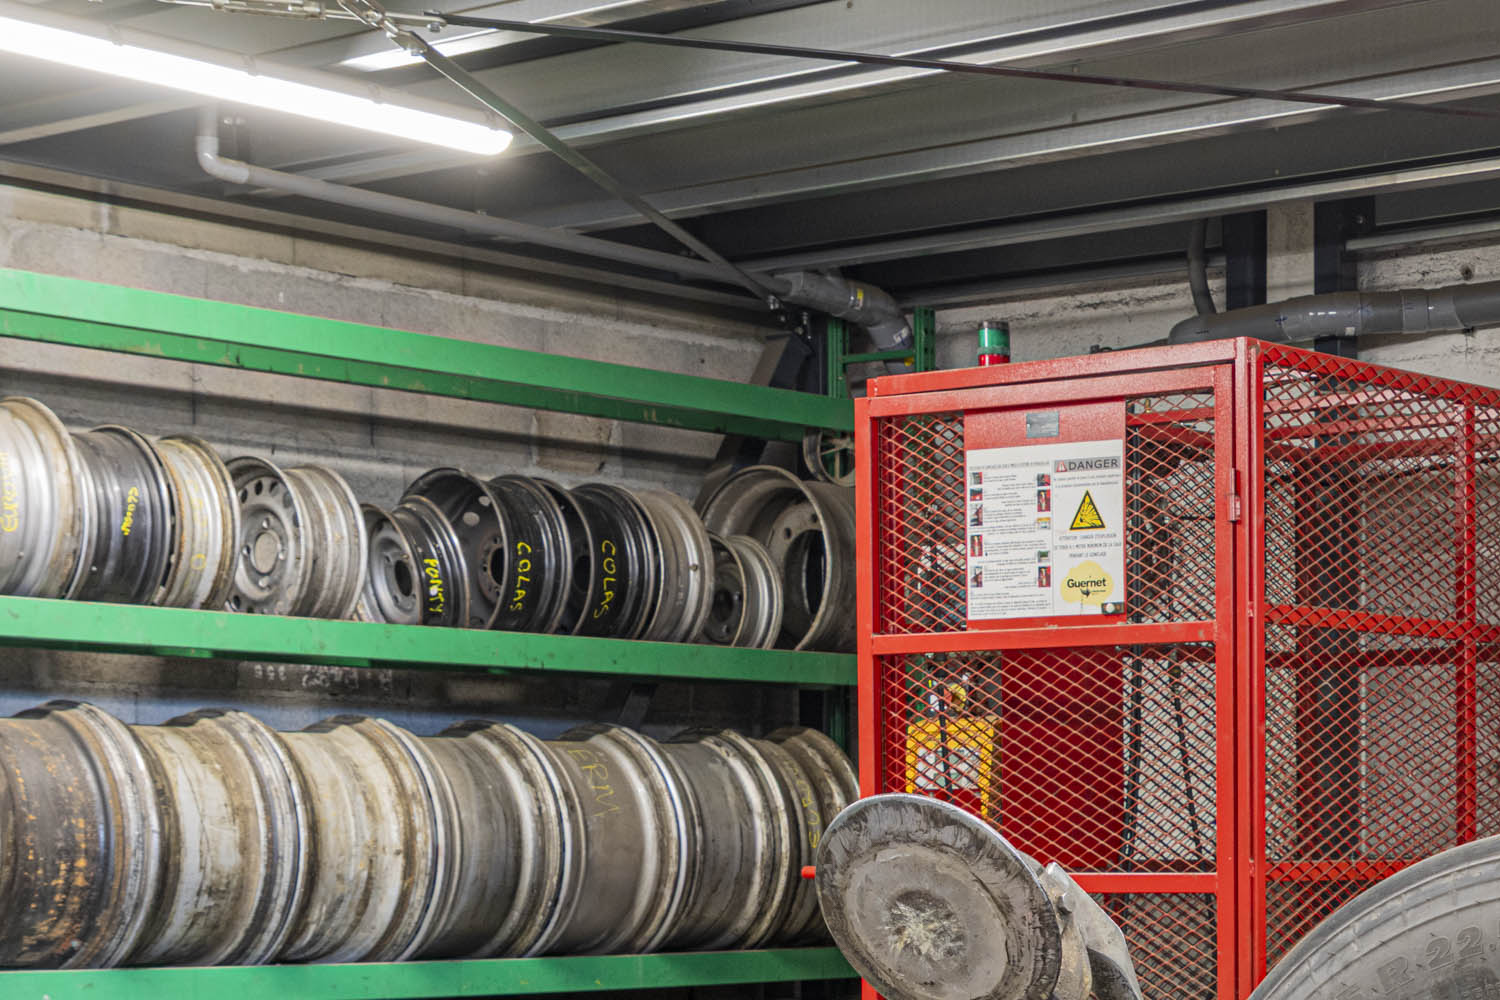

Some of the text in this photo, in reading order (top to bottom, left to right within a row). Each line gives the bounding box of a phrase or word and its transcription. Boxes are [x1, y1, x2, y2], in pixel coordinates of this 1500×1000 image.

[1068, 458, 1119, 471] DANGER
[423, 558, 445, 613] PONTY
[510, 541, 532, 611] COLAS
[593, 539, 617, 618] COLAS
[1067, 577, 1107, 588] Guernet
